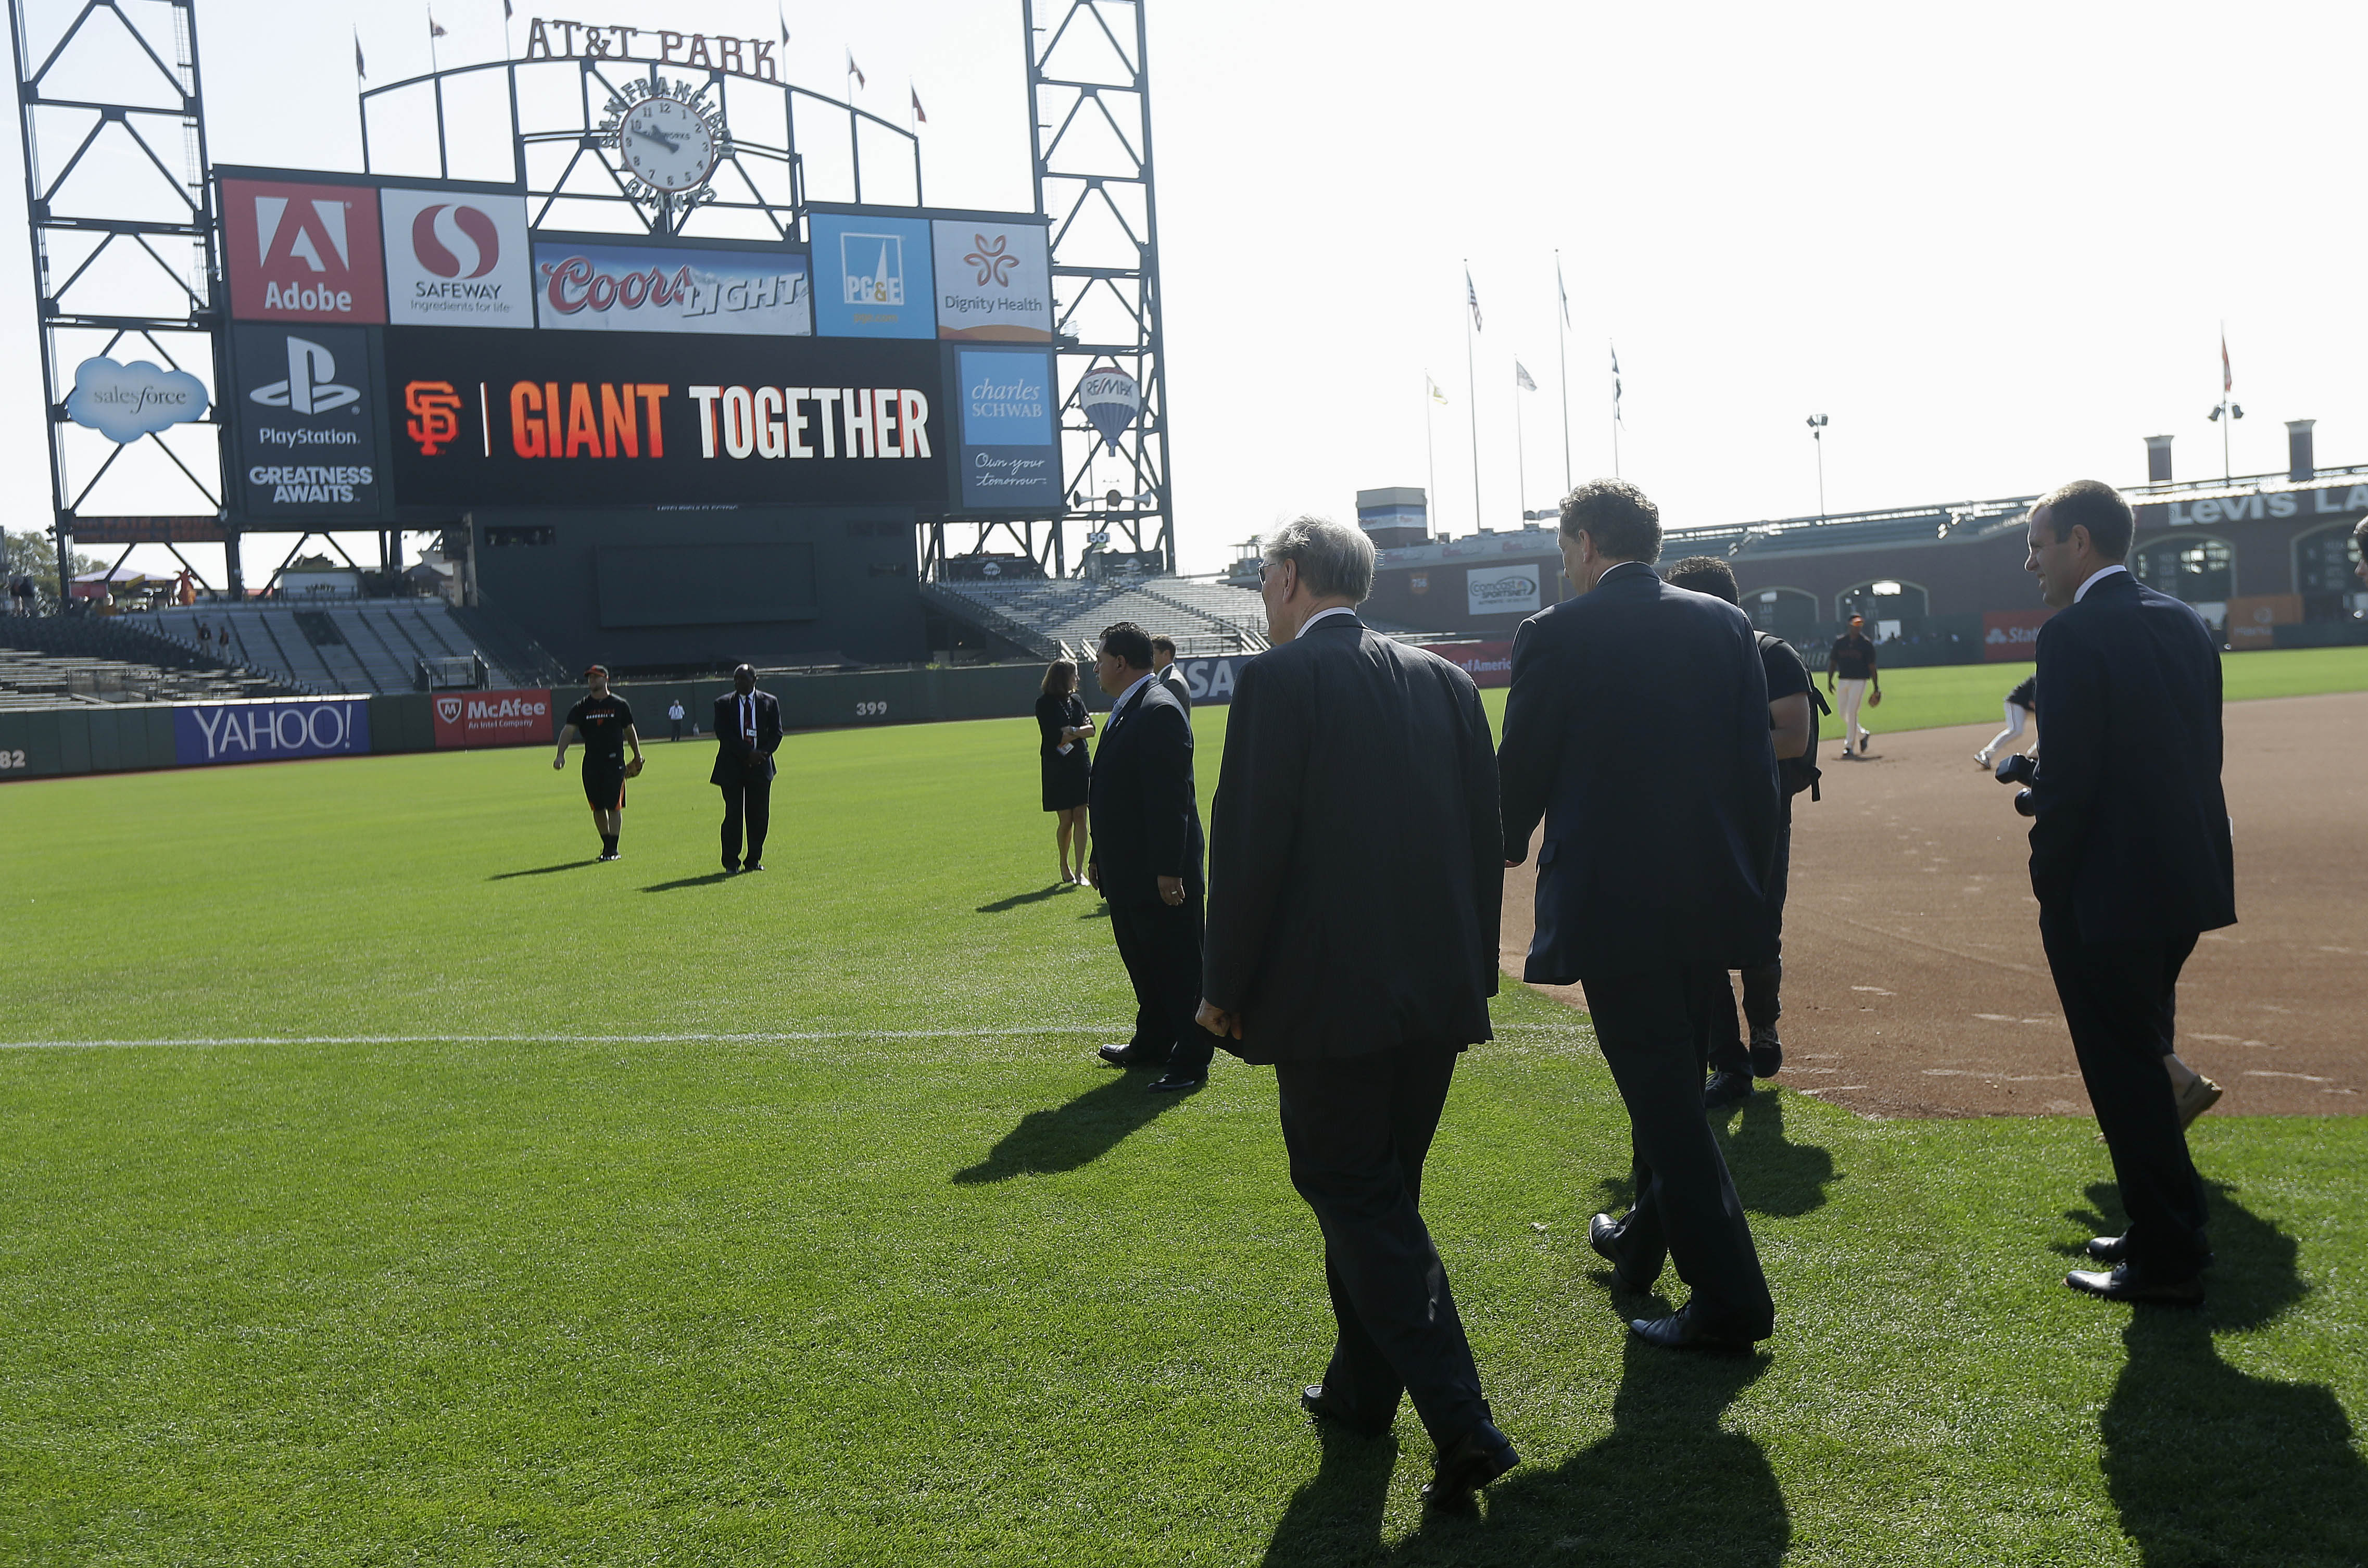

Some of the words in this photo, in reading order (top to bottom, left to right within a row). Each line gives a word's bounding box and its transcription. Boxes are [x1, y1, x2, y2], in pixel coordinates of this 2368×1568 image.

[526, 18, 637, 61] AT&T
[657, 30, 779, 83] PARK
[643, 107, 653, 118] 11
[659, 103, 671, 113] 12
[682, 109, 687, 120] 1
[630, 119, 642, 130] 10
[695, 123, 702, 133] 2
[625, 136, 633, 147] 9
[701, 142, 709, 153] 3
[633, 156, 640, 167] 8
[696, 160, 703, 170] 4
[649, 169, 656, 180] 7
[666, 175, 674, 186] 6
[684, 171, 691, 182] 5
[626, 177, 717, 213] GIANTS
[415, 282, 502, 299] SAFEWAY
[540, 256, 695, 315] Coors
[682, 272, 805, 318] LIGHT
[846, 274, 902, 303] PG&E
[264, 281, 351, 312] Adobe
[944, 295, 994, 313] Dignity
[998, 297, 1042, 311] Health
[409, 298, 473, 314] Ingredients
[475, 301, 492, 313] for
[493, 302, 509, 314] life
[853, 313, 898, 324] pge.com
[971, 378, 1041, 400] charles
[1087, 378, 1133, 397] RE/MAX
[94, 384, 187, 415] salesforce
[972, 403, 1042, 417] SCHWAB
[510, 381, 670, 460] GIANT
[688, 384, 932, 460] TOGETHER
[260, 428, 358, 449] PlayStation
[975, 452, 1007, 468] Own
[1009, 459, 1044, 476] your
[249, 466, 373, 485] GREATNESS
[976, 472, 1047, 486] tomorrow
[273, 485, 355, 503] AWAITS
[2009, 627, 2038, 642] Stat
[1474, 657, 1511, 672] Americ
[468, 697, 546, 719] McAfee
[855, 701, 887, 716] 399
[193, 703, 352, 758] YAHOO!
[481, 720, 497, 729] Intel
[499, 718, 533, 728] Company
